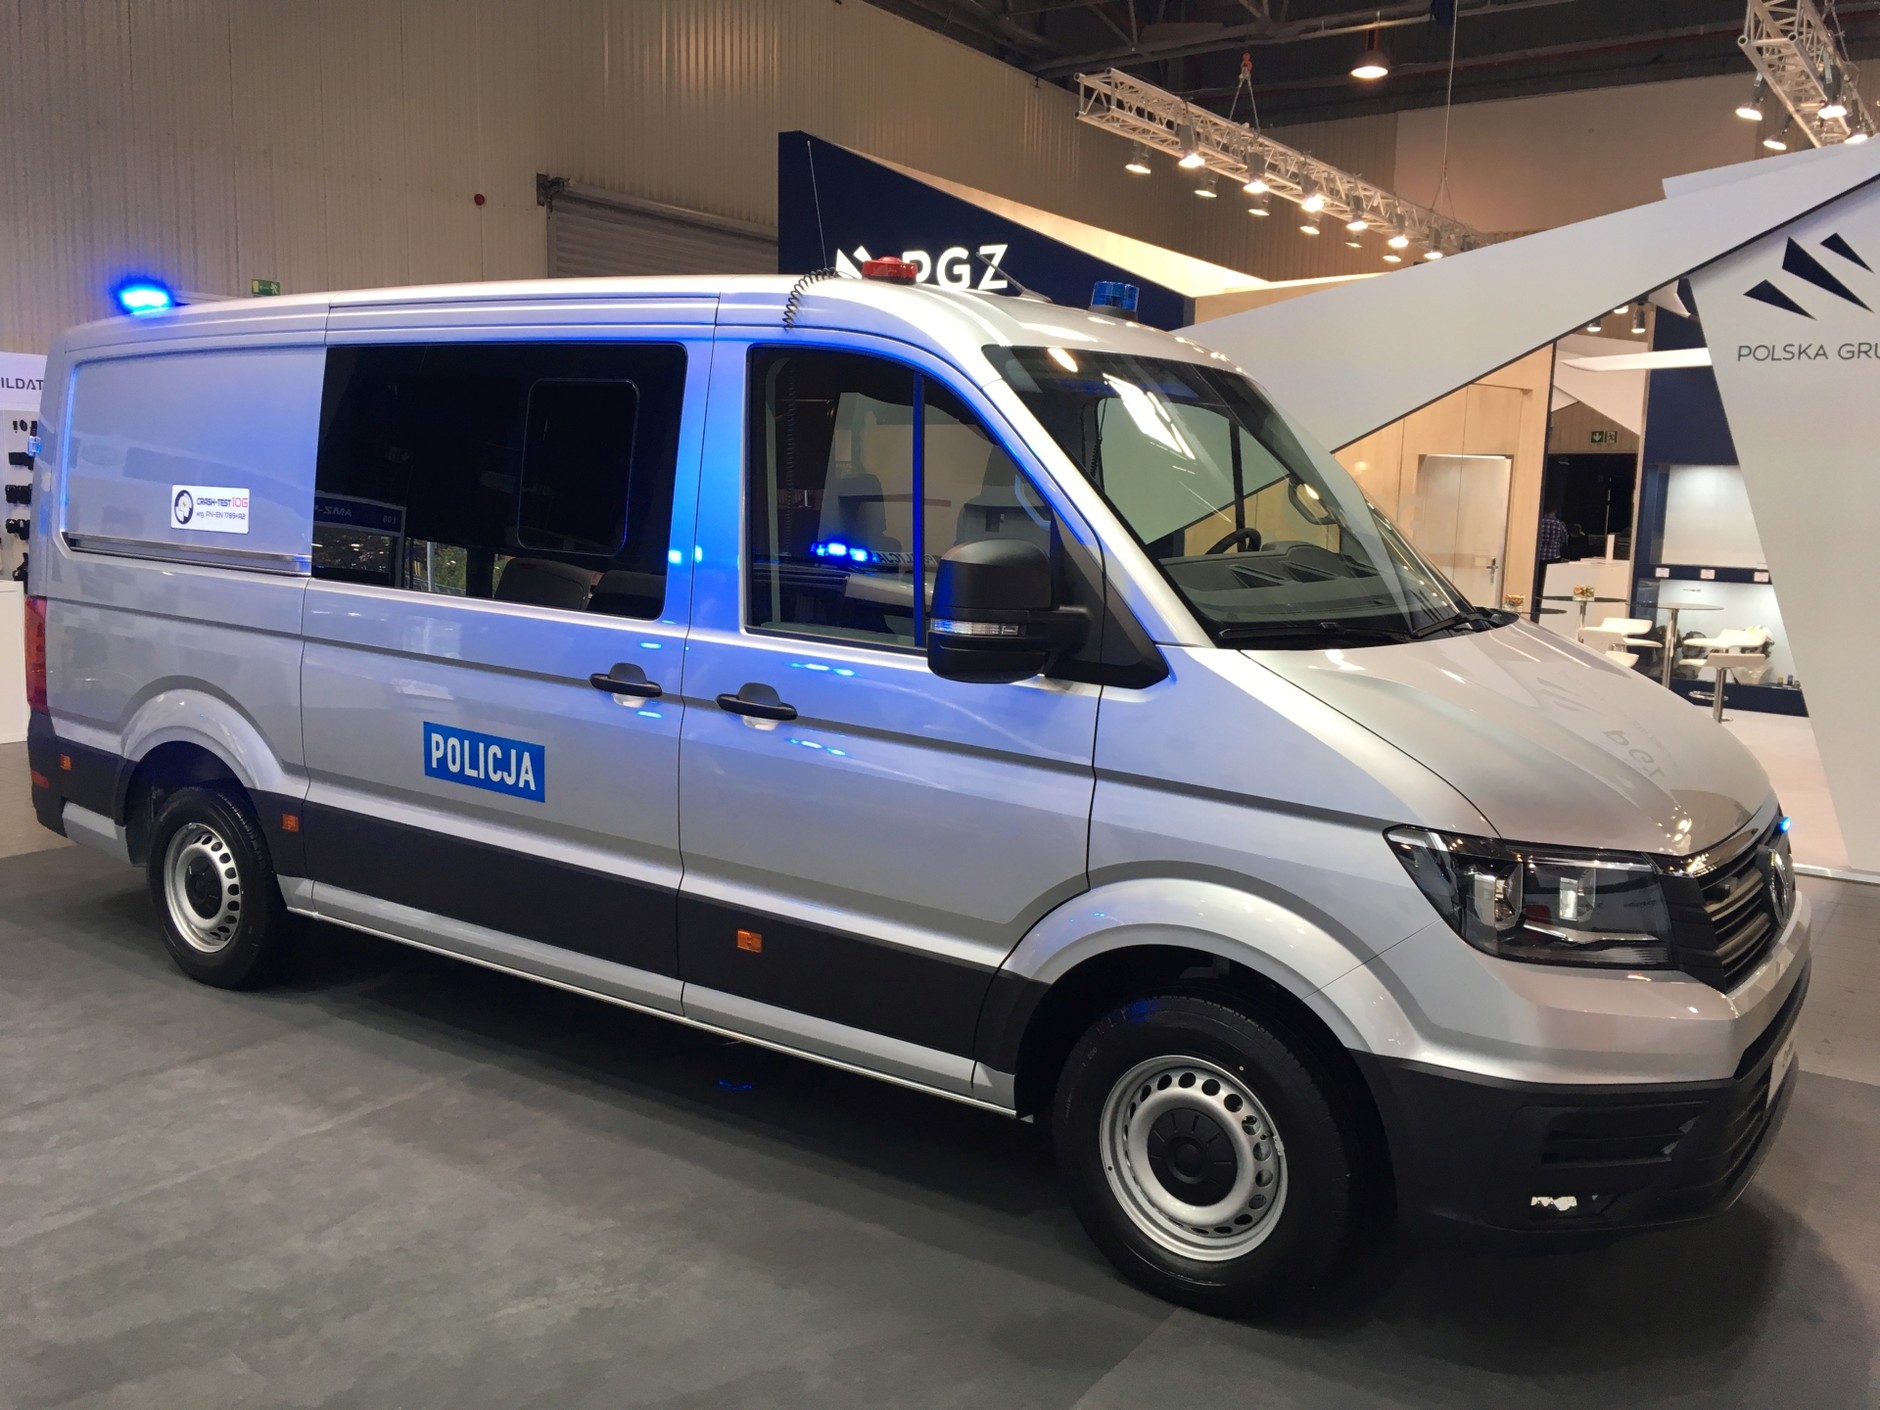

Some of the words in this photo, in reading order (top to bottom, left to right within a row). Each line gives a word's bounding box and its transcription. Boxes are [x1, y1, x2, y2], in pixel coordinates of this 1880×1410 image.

[1737, 343, 1828, 362] POLSKA
[1, 377, 44, 391] ILDAT
[431, 732, 536, 791] POLICJA
